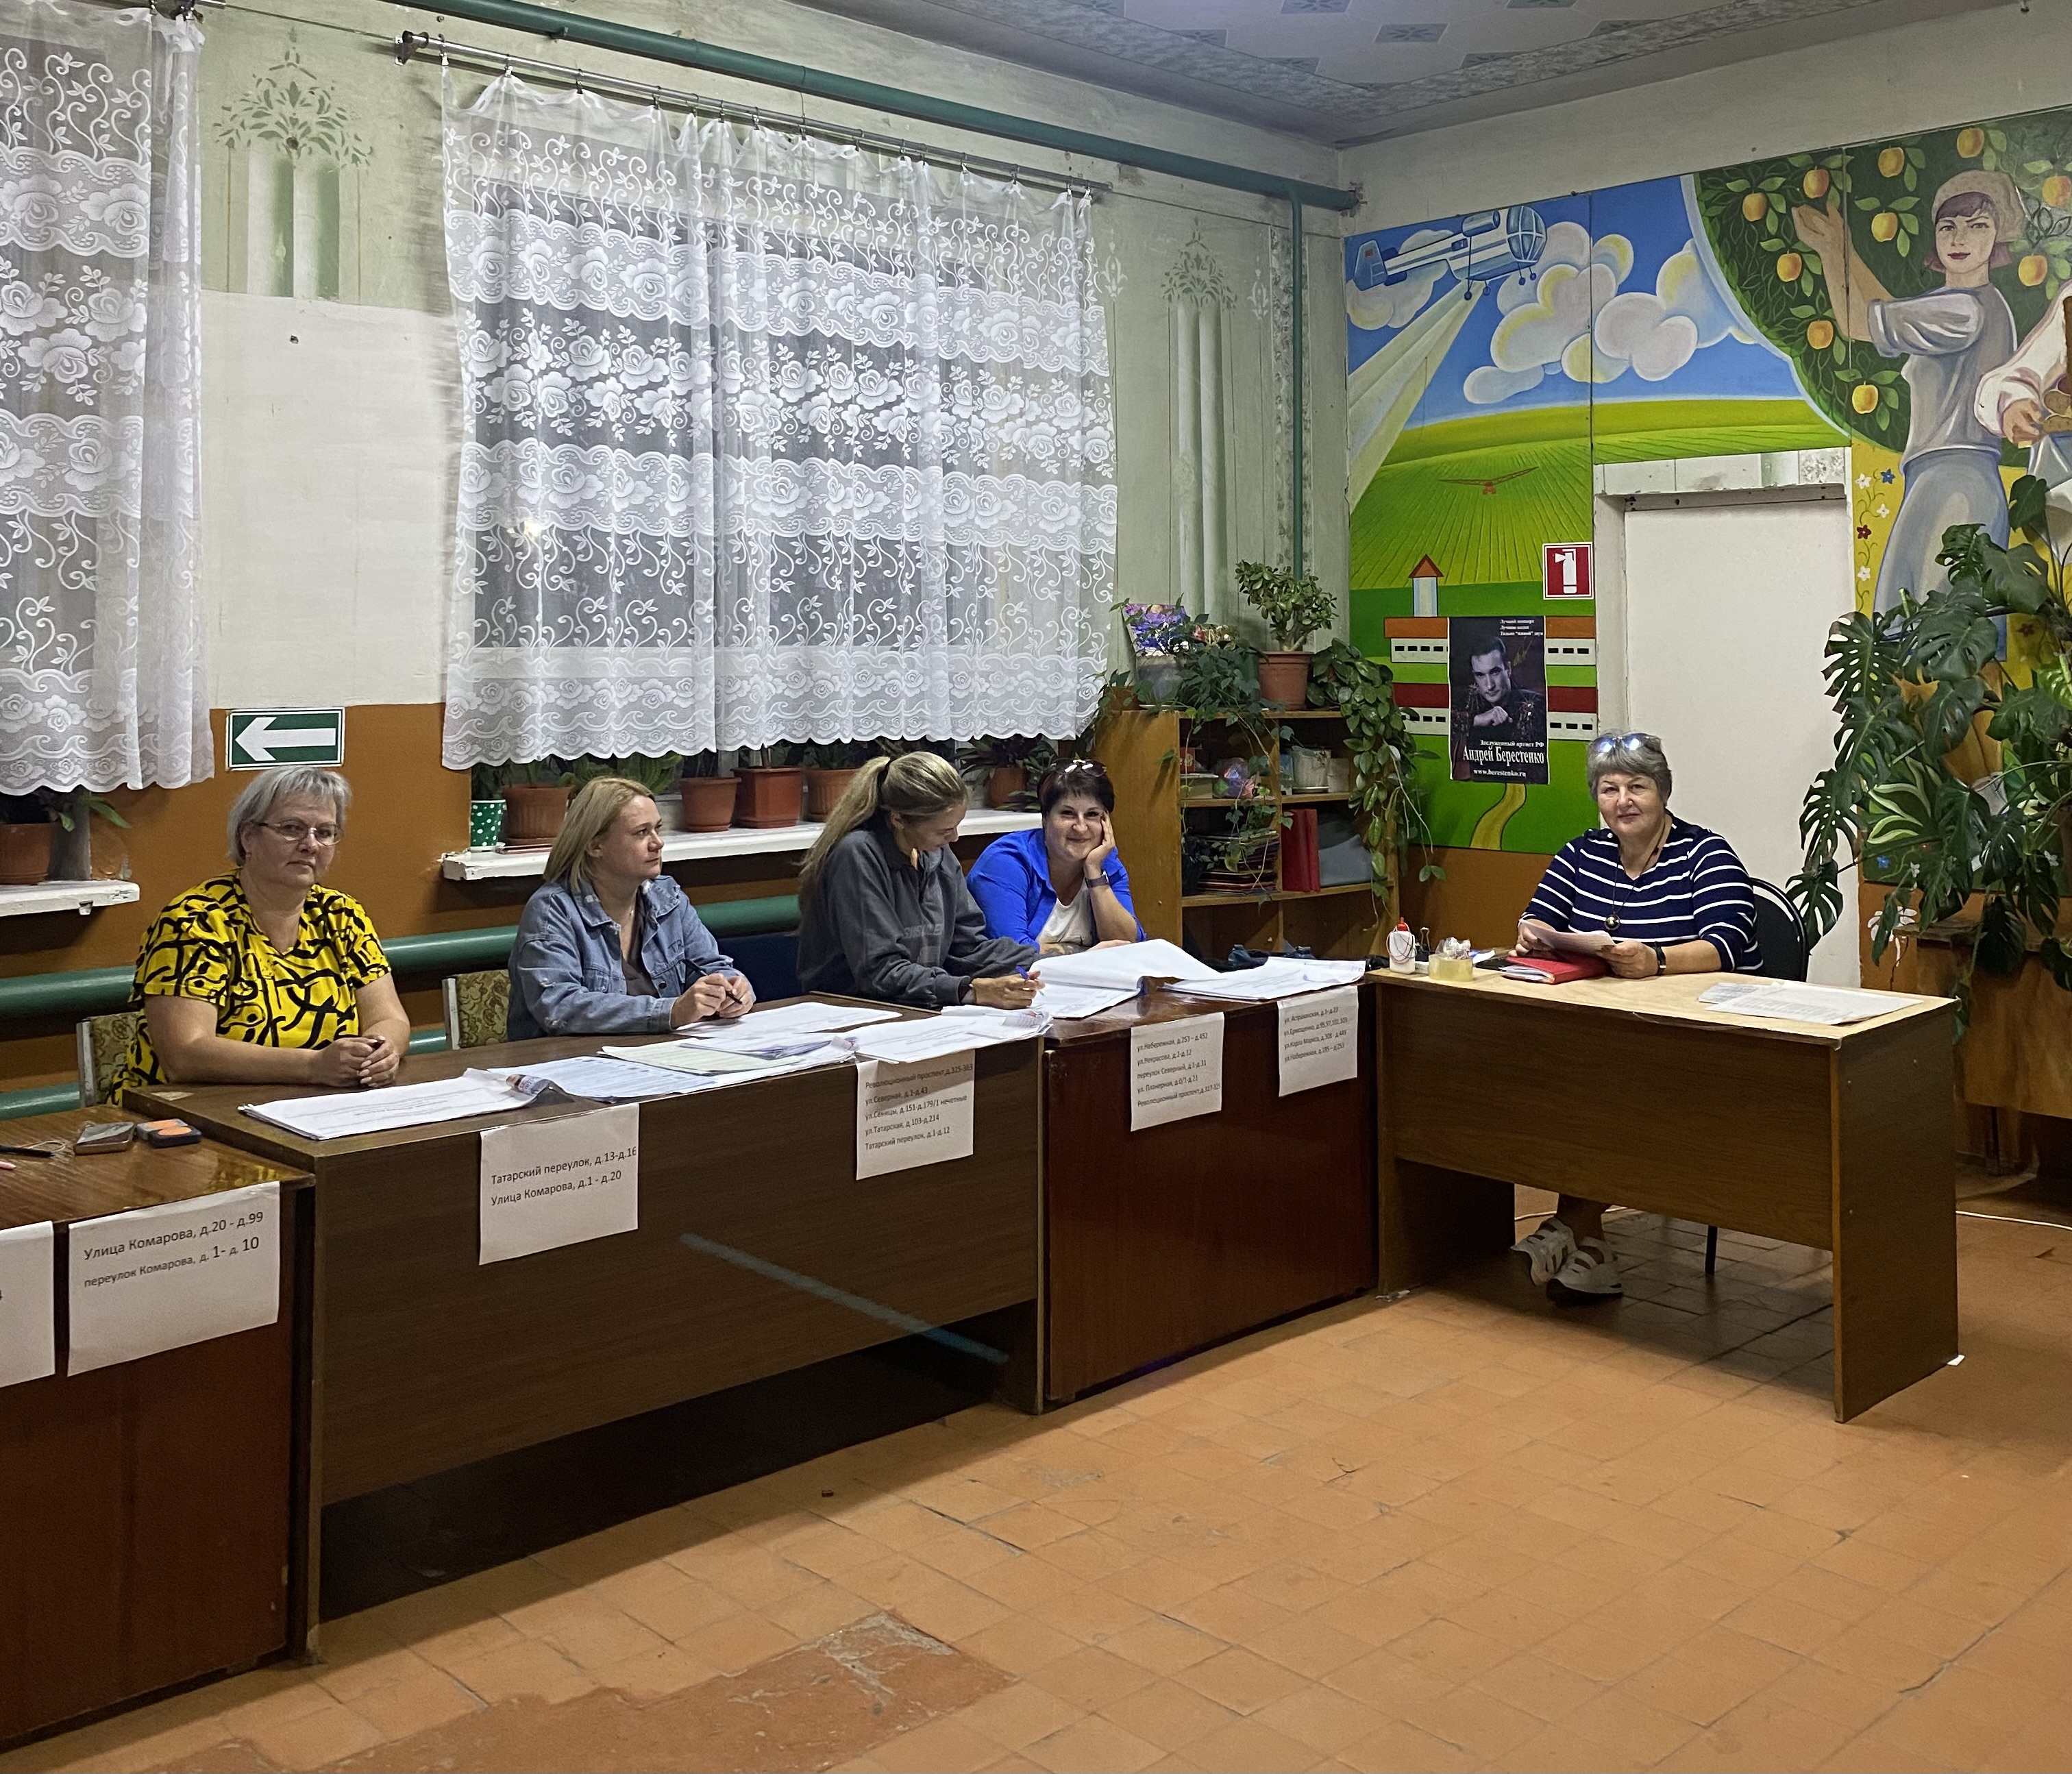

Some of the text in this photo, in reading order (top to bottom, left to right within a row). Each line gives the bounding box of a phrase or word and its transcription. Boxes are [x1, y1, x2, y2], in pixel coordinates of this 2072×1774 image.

[1463, 745, 1544, 767] Андрей Берестенко
[1194, 1032, 1208, 1042] д.452
[865, 1137, 896, 1150] Татарский
[491, 1146, 637, 1185] Татарский переулок, д.13-д.16
[491, 1193, 522, 1207] Улица
[523, 1183, 576, 1199] Комарова,
[84, 1242, 125, 1261] Улица
[127, 1229, 197, 1251] Комарова,
[199, 1219, 227, 1237] д.20
[236, 1211, 264, 1229] д.99
[84, 1268, 138, 1288] переулок
[138, 1257, 197, 1277] Комарова,
[242, 1236, 260, 1252] 10
